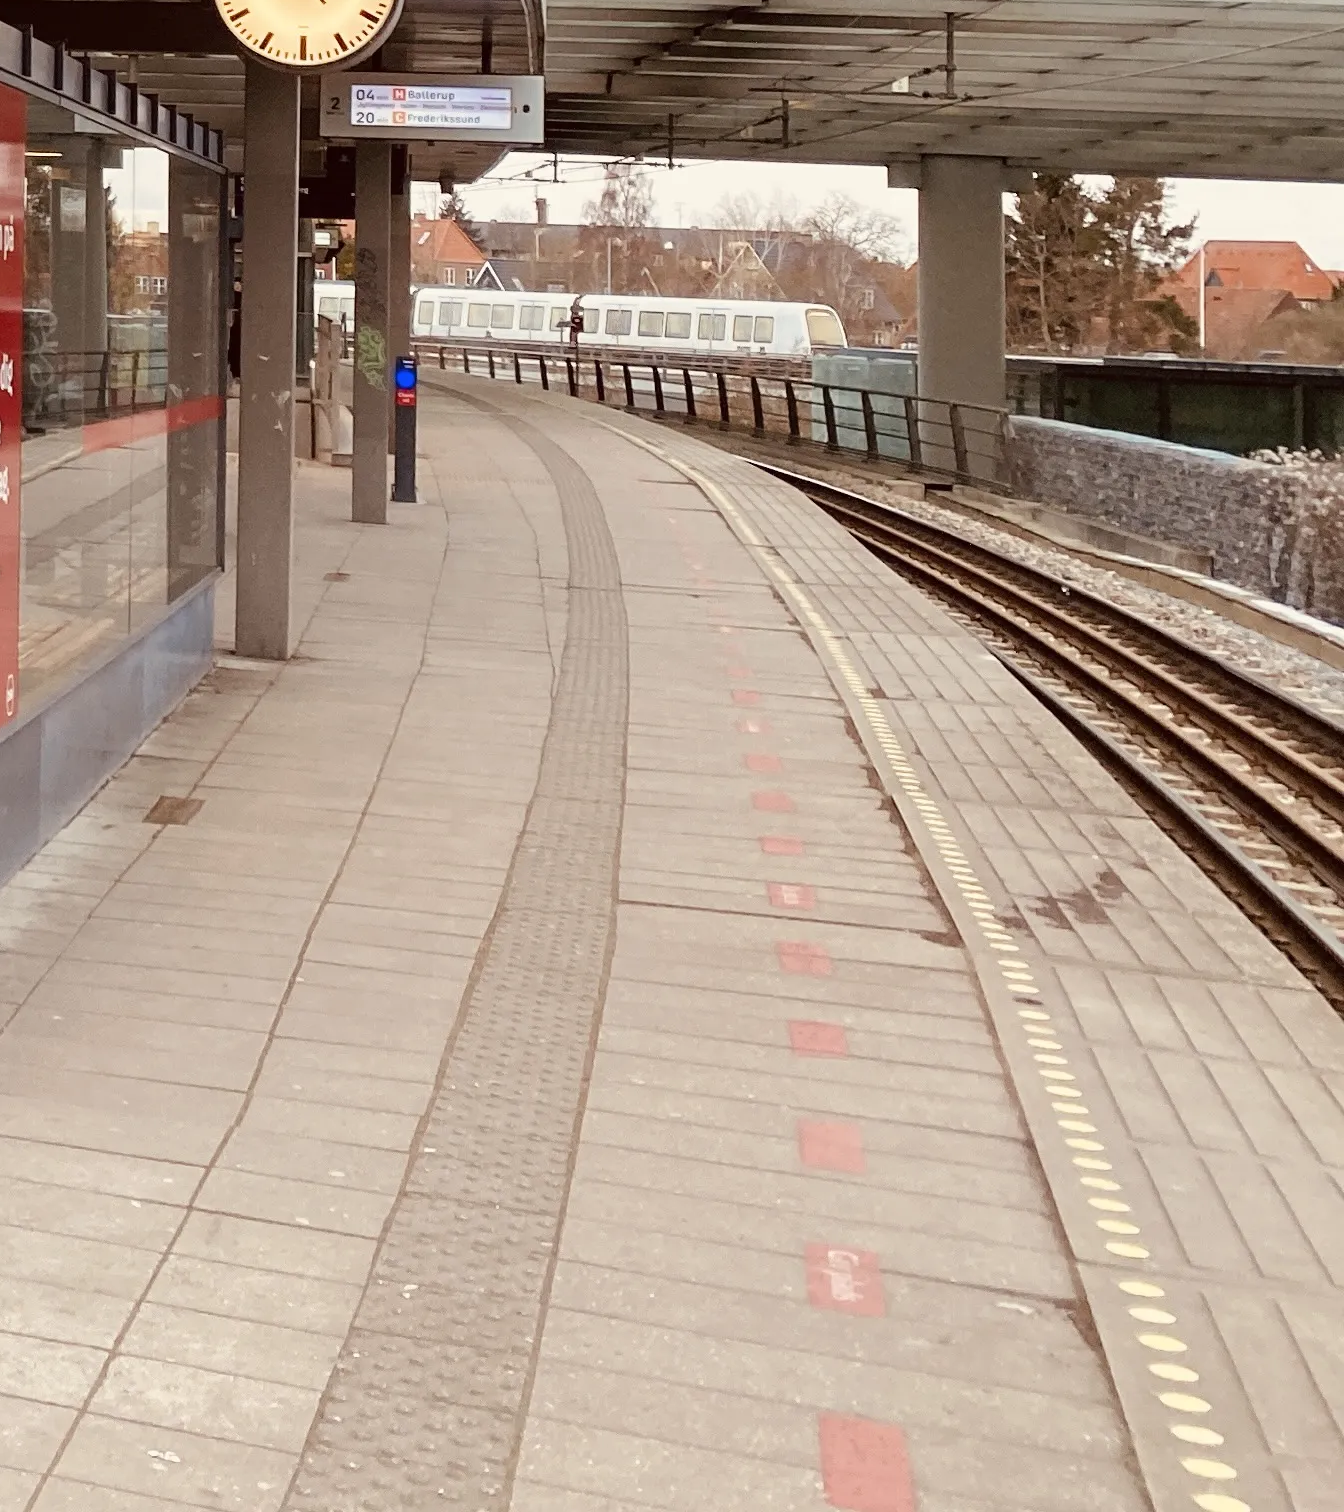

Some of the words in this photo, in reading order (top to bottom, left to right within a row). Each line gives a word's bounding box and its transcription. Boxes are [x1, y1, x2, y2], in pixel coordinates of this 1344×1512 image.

[356, 89, 375, 101] 04
[395, 89, 406, 100] H
[408, 90, 456, 101] Ballerup
[330, 96, 341, 110] 2
[356, 112, 375, 124] 20
[395, 112, 406, 123] C
[408, 113, 481, 124] Frederikssund
[3, 214, 15, 261] på
[0, 353, 14, 397] dig
